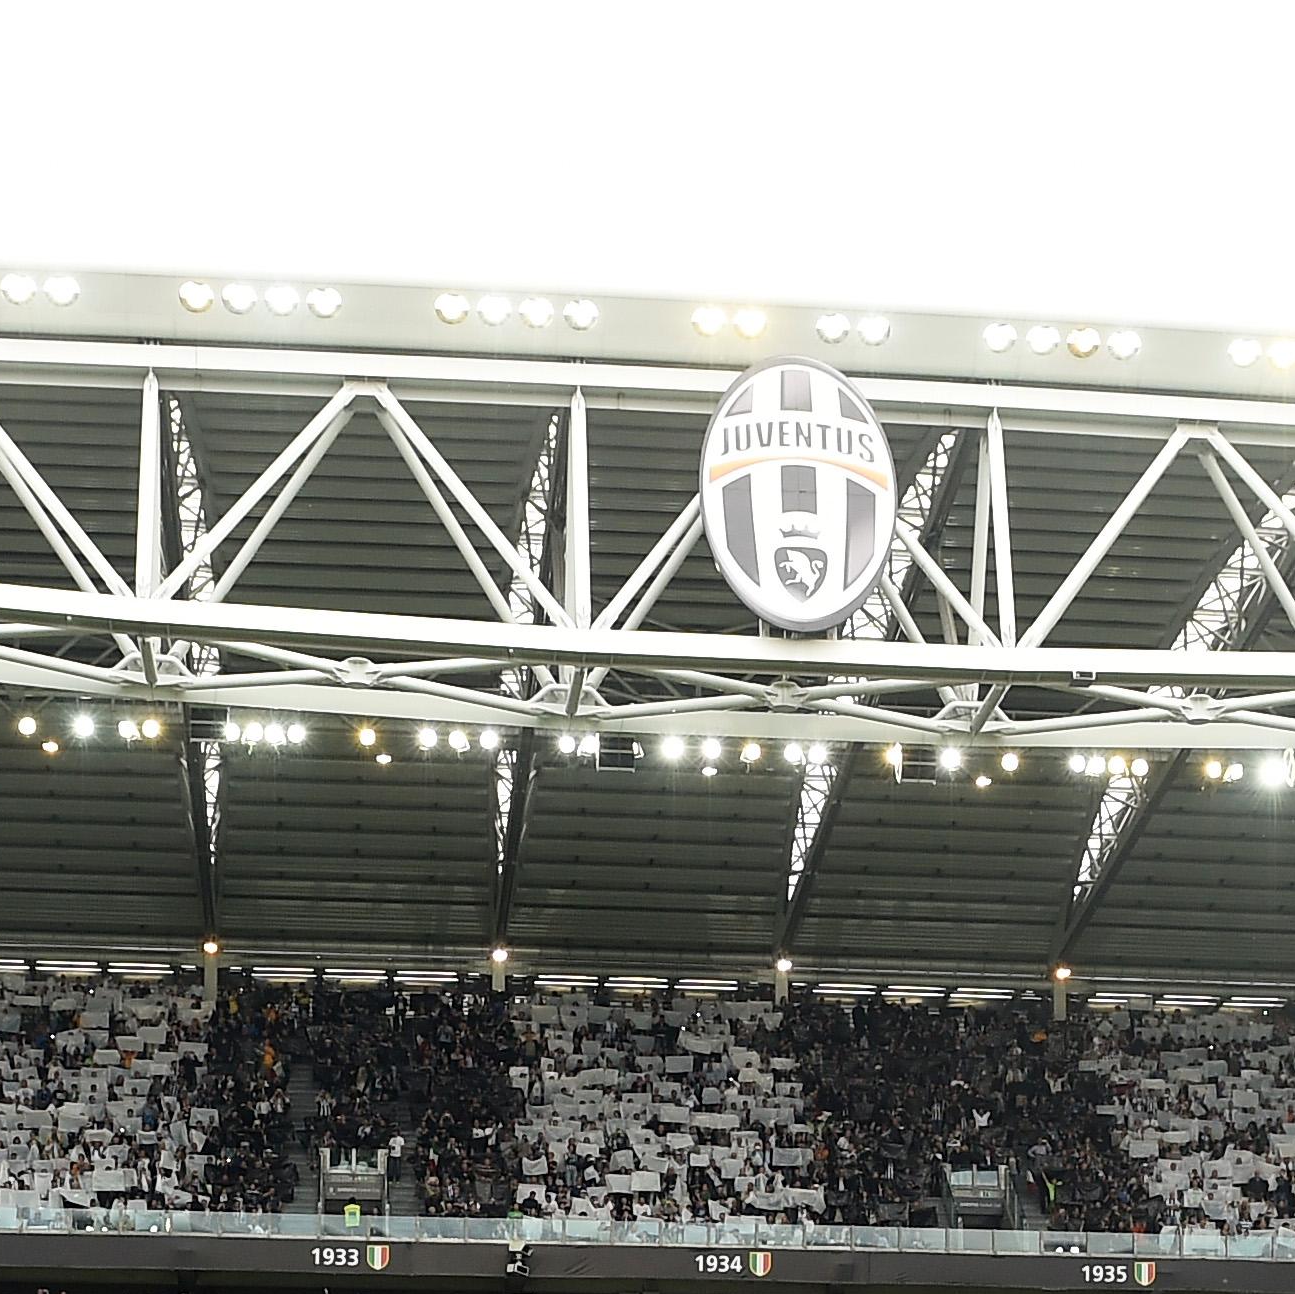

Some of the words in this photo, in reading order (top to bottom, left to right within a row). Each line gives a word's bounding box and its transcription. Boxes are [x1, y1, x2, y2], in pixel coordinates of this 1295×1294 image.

[721, 420, 875, 463] JUVENTUS
[311, 1247, 359, 1267] 1933
[694, 1254, 743, 1273] 1934
[1081, 1265, 1128, 1283] 1935
